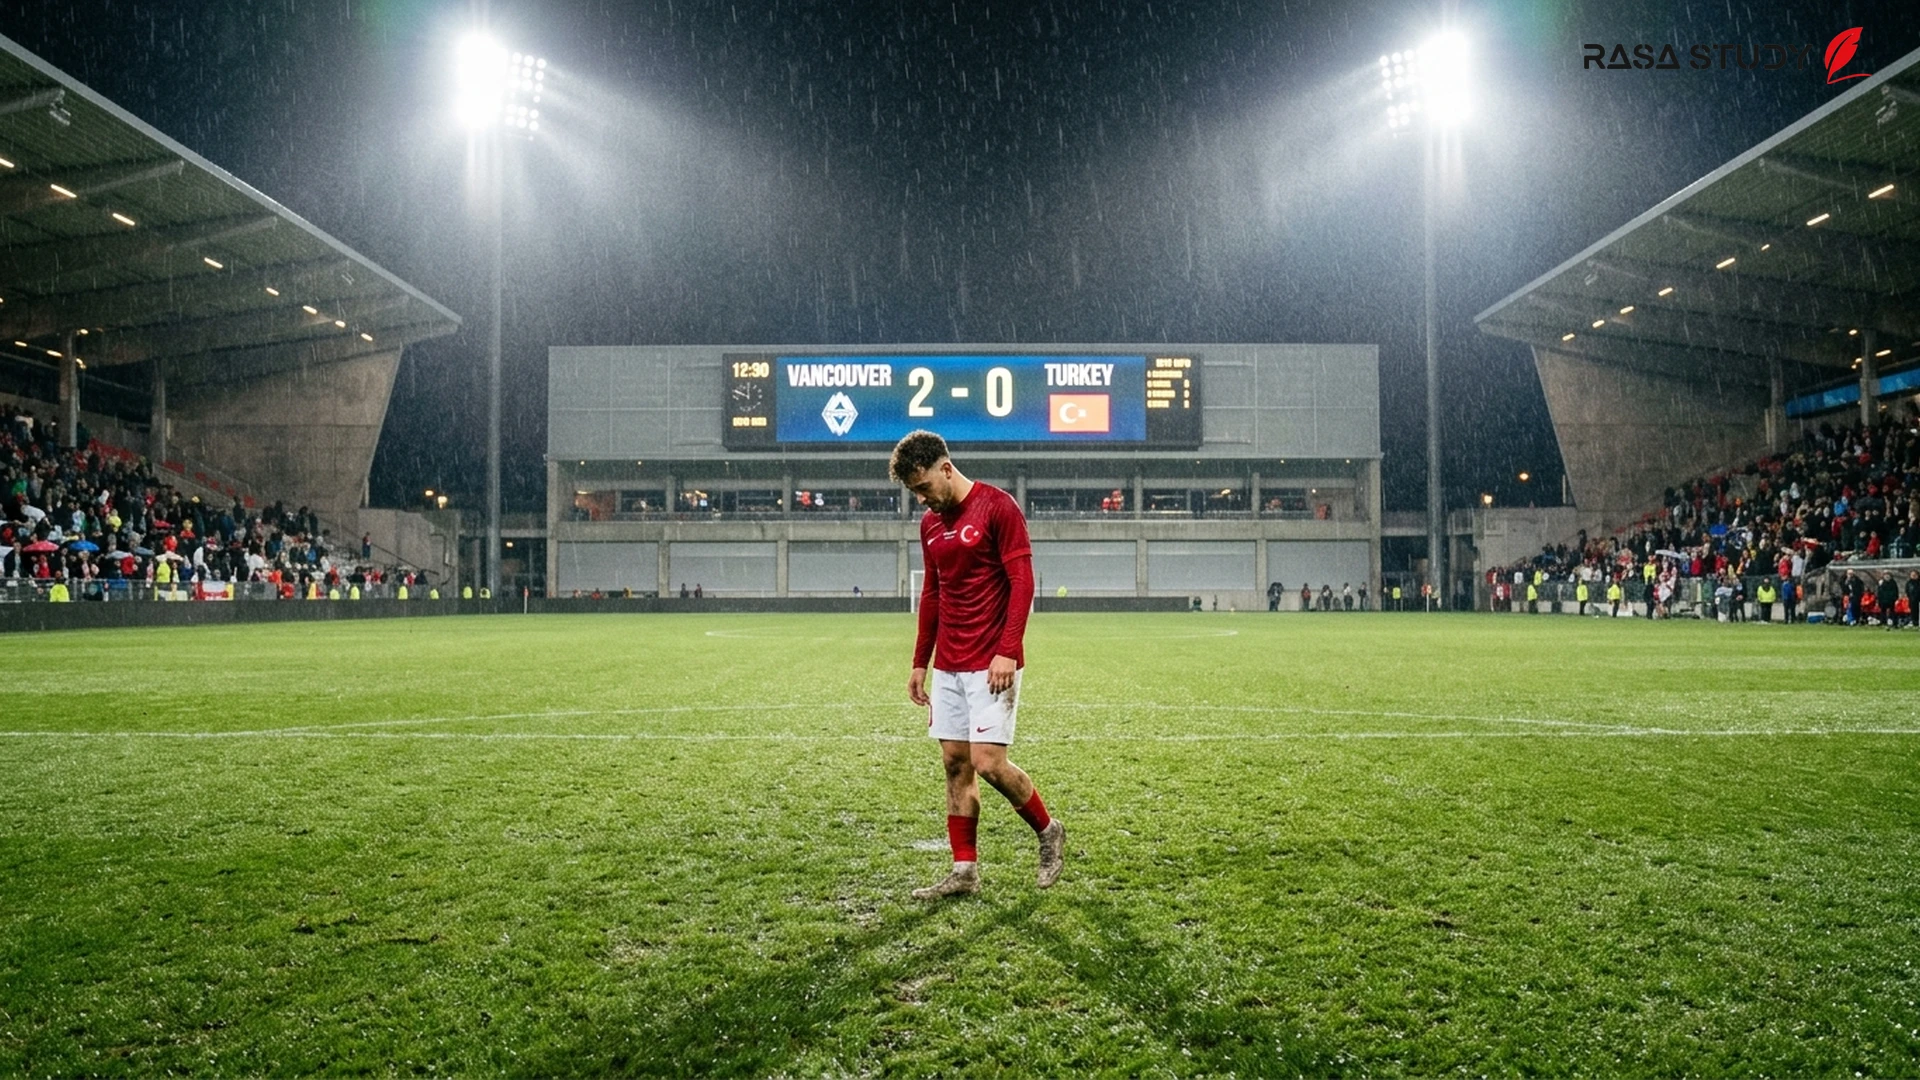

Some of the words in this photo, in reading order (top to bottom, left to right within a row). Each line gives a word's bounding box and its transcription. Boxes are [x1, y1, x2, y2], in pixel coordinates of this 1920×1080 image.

[787, 364, 892, 387] VANCOUVER
[1044, 363, 1114, 386] TURKEY
[908, 367, 934, 417] 2
[985, 366, 1013, 418] 0
